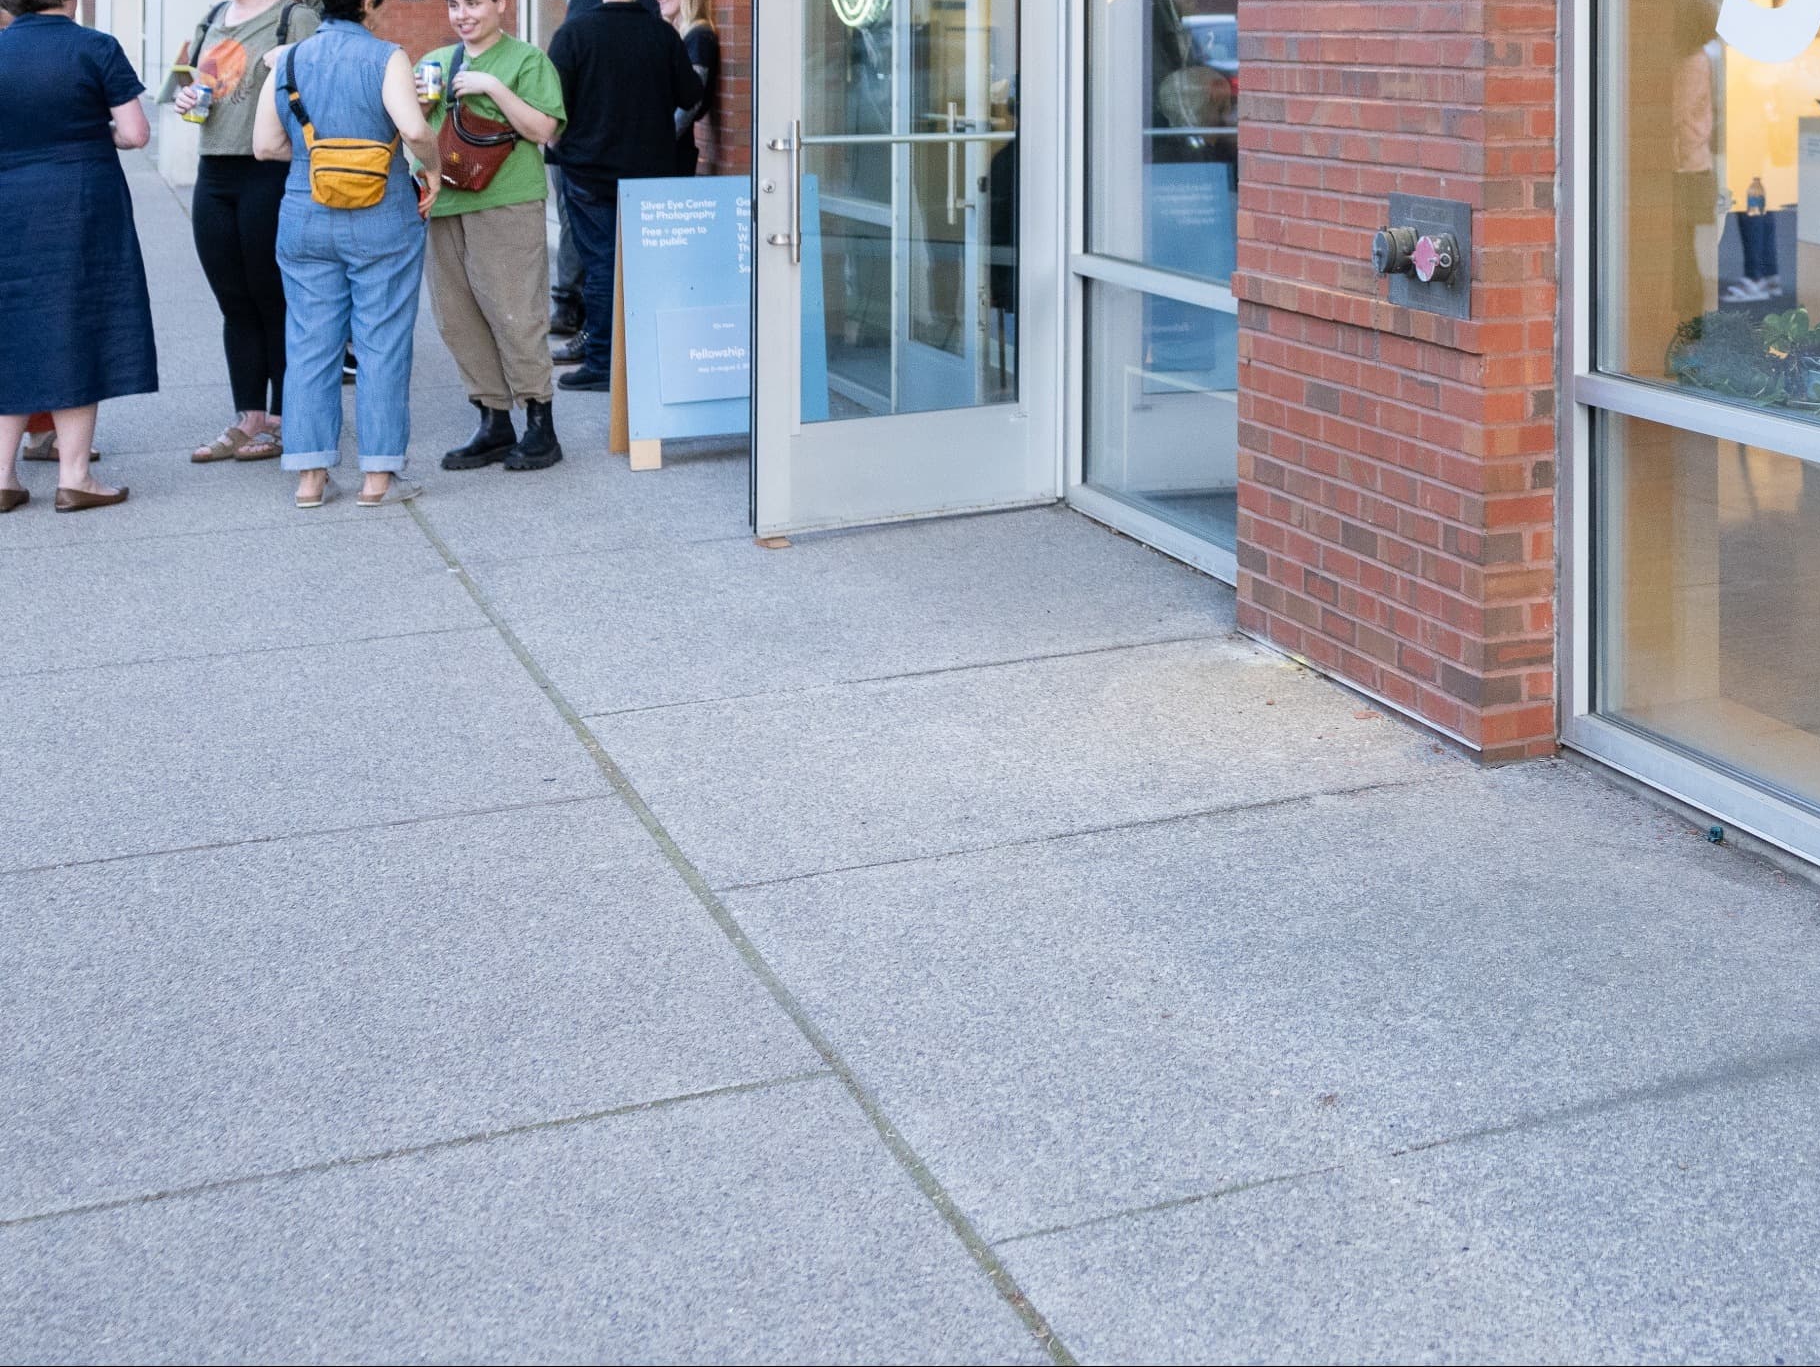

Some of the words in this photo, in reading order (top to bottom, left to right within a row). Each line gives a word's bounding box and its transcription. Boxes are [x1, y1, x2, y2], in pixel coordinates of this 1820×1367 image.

[640, 200, 665, 210] Silver
[667, 200, 684, 210] Eye
[685, 199, 716, 209] Center
[641, 212, 653, 221] for
[656, 210, 716, 220] Photography
[641, 226, 662, 236] Free
[671, 227, 695, 236] open
[697, 226, 707, 234] to
[642, 237, 658, 246] the
[659, 236, 688, 247] public
[689, 346, 745, 360] Fellowship
